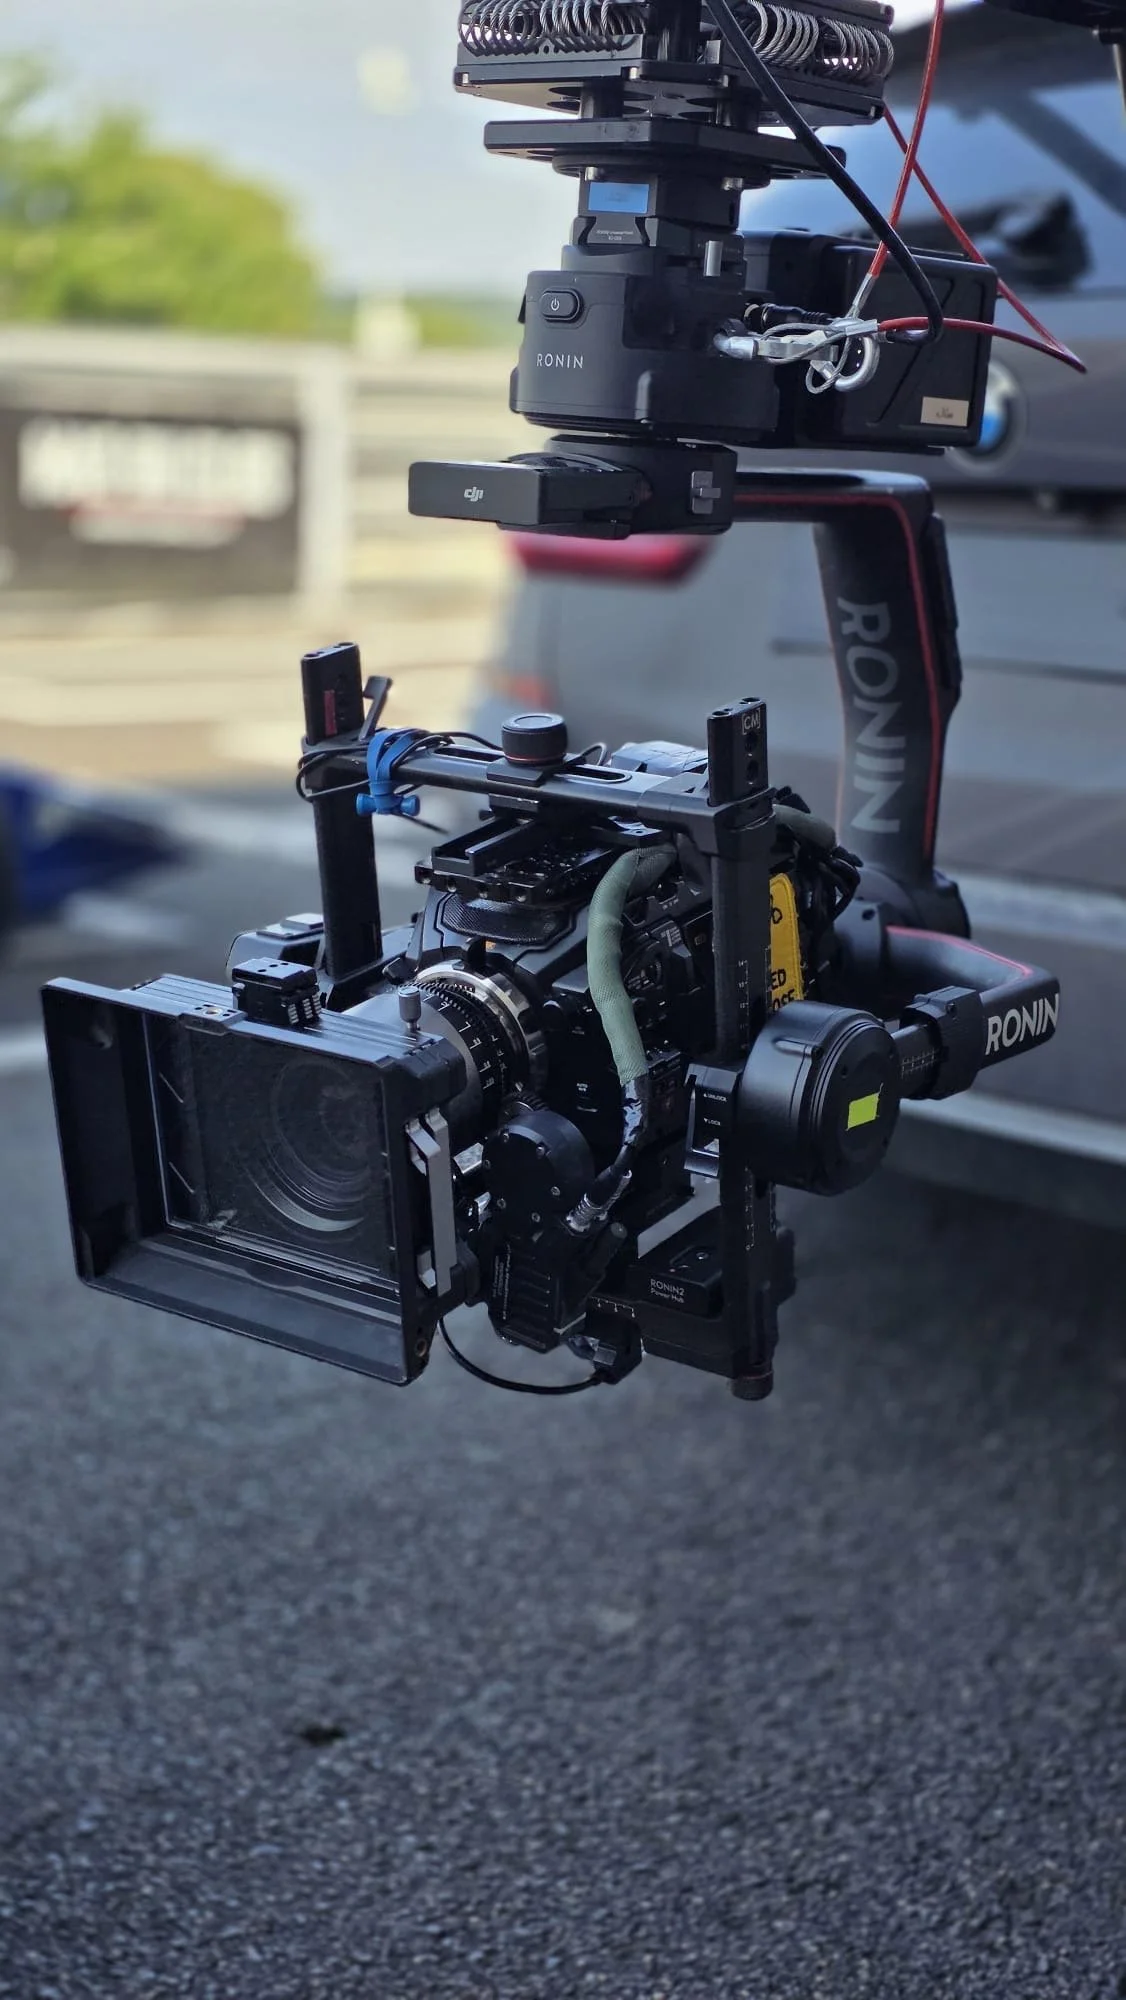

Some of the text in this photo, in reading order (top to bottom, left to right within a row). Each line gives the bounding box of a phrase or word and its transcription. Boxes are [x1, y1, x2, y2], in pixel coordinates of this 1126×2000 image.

[536, 353, 583, 369] RONIN
[837, 597, 906, 833] RONIN
[985, 993, 1060, 1055] RONIN
[650, 1278, 685, 1296] RONIN2
